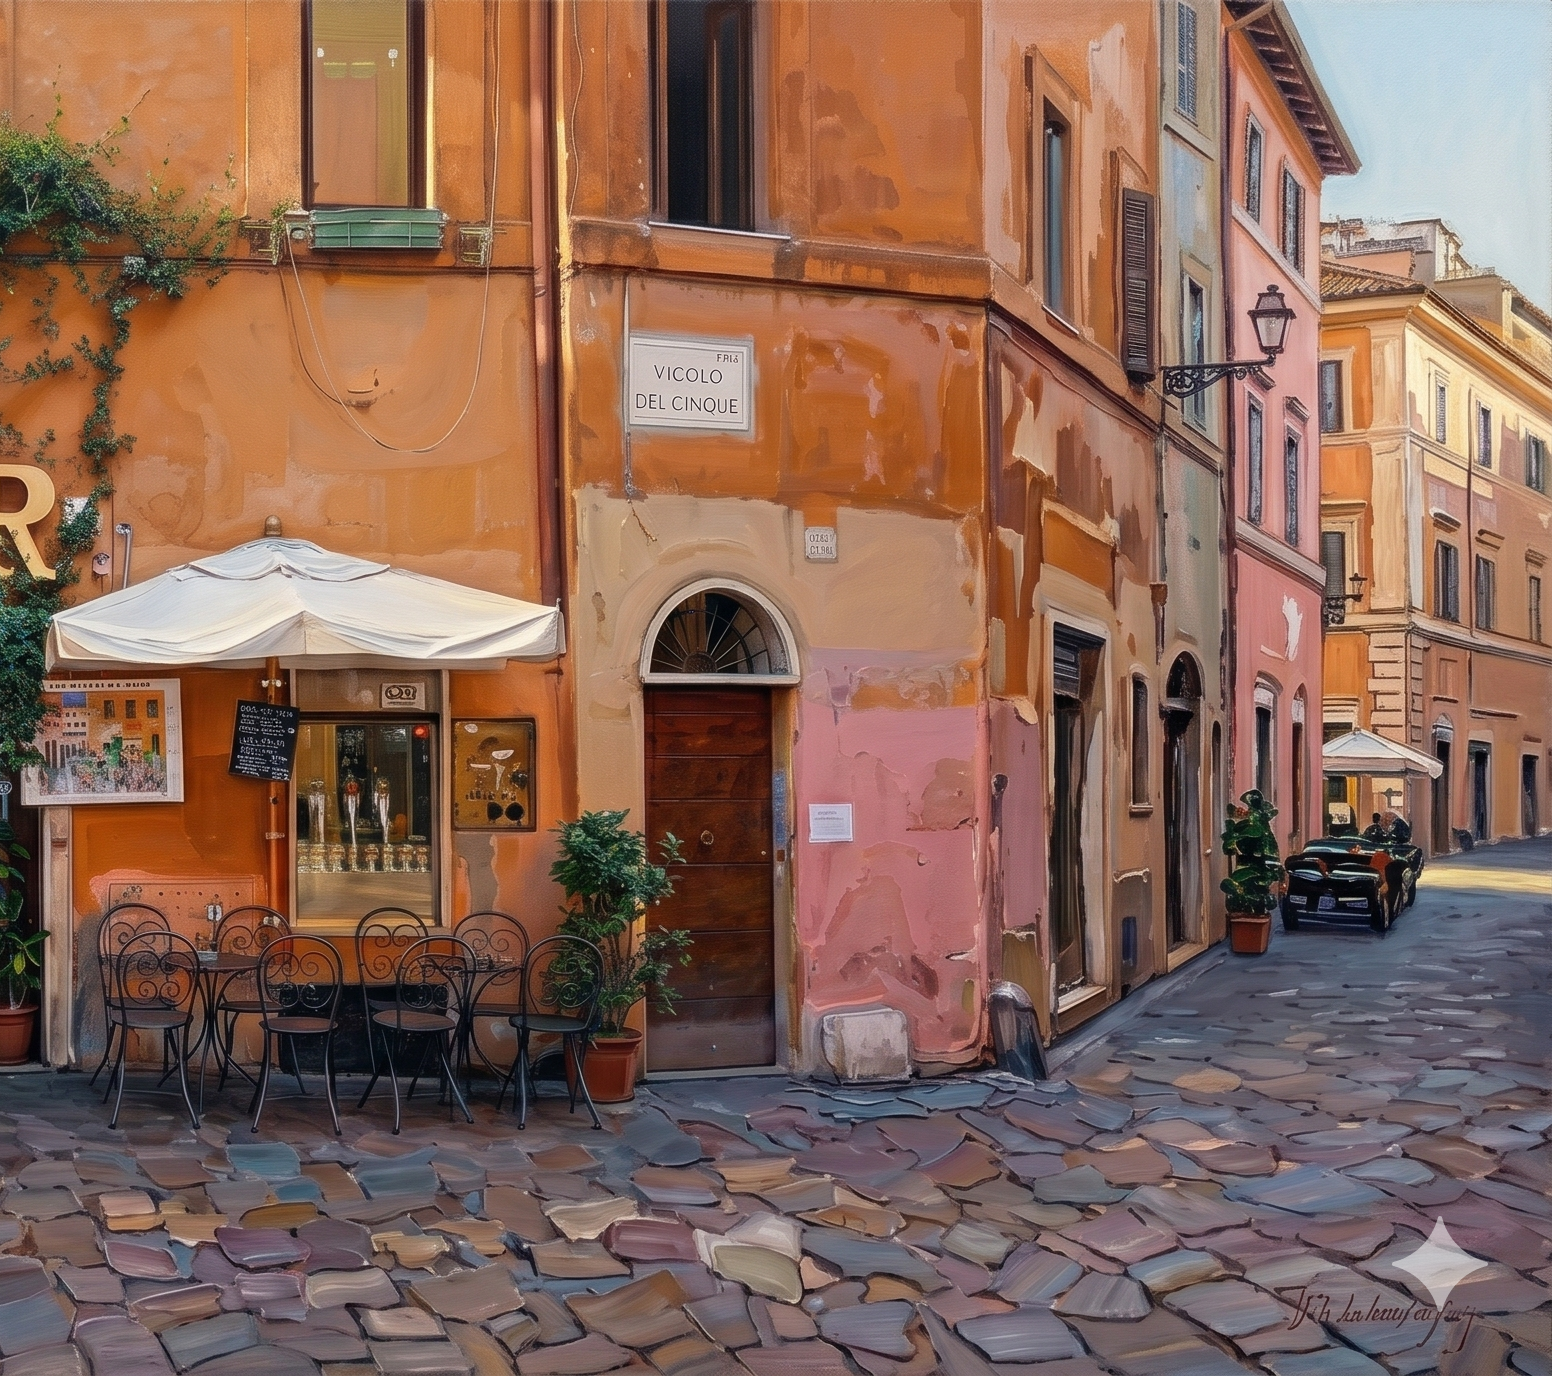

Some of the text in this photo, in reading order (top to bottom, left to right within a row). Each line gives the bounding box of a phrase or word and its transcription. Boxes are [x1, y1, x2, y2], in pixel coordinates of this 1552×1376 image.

[653, 364, 723, 384] VICOLO
[635, 393, 739, 416] DEL CINQUE
